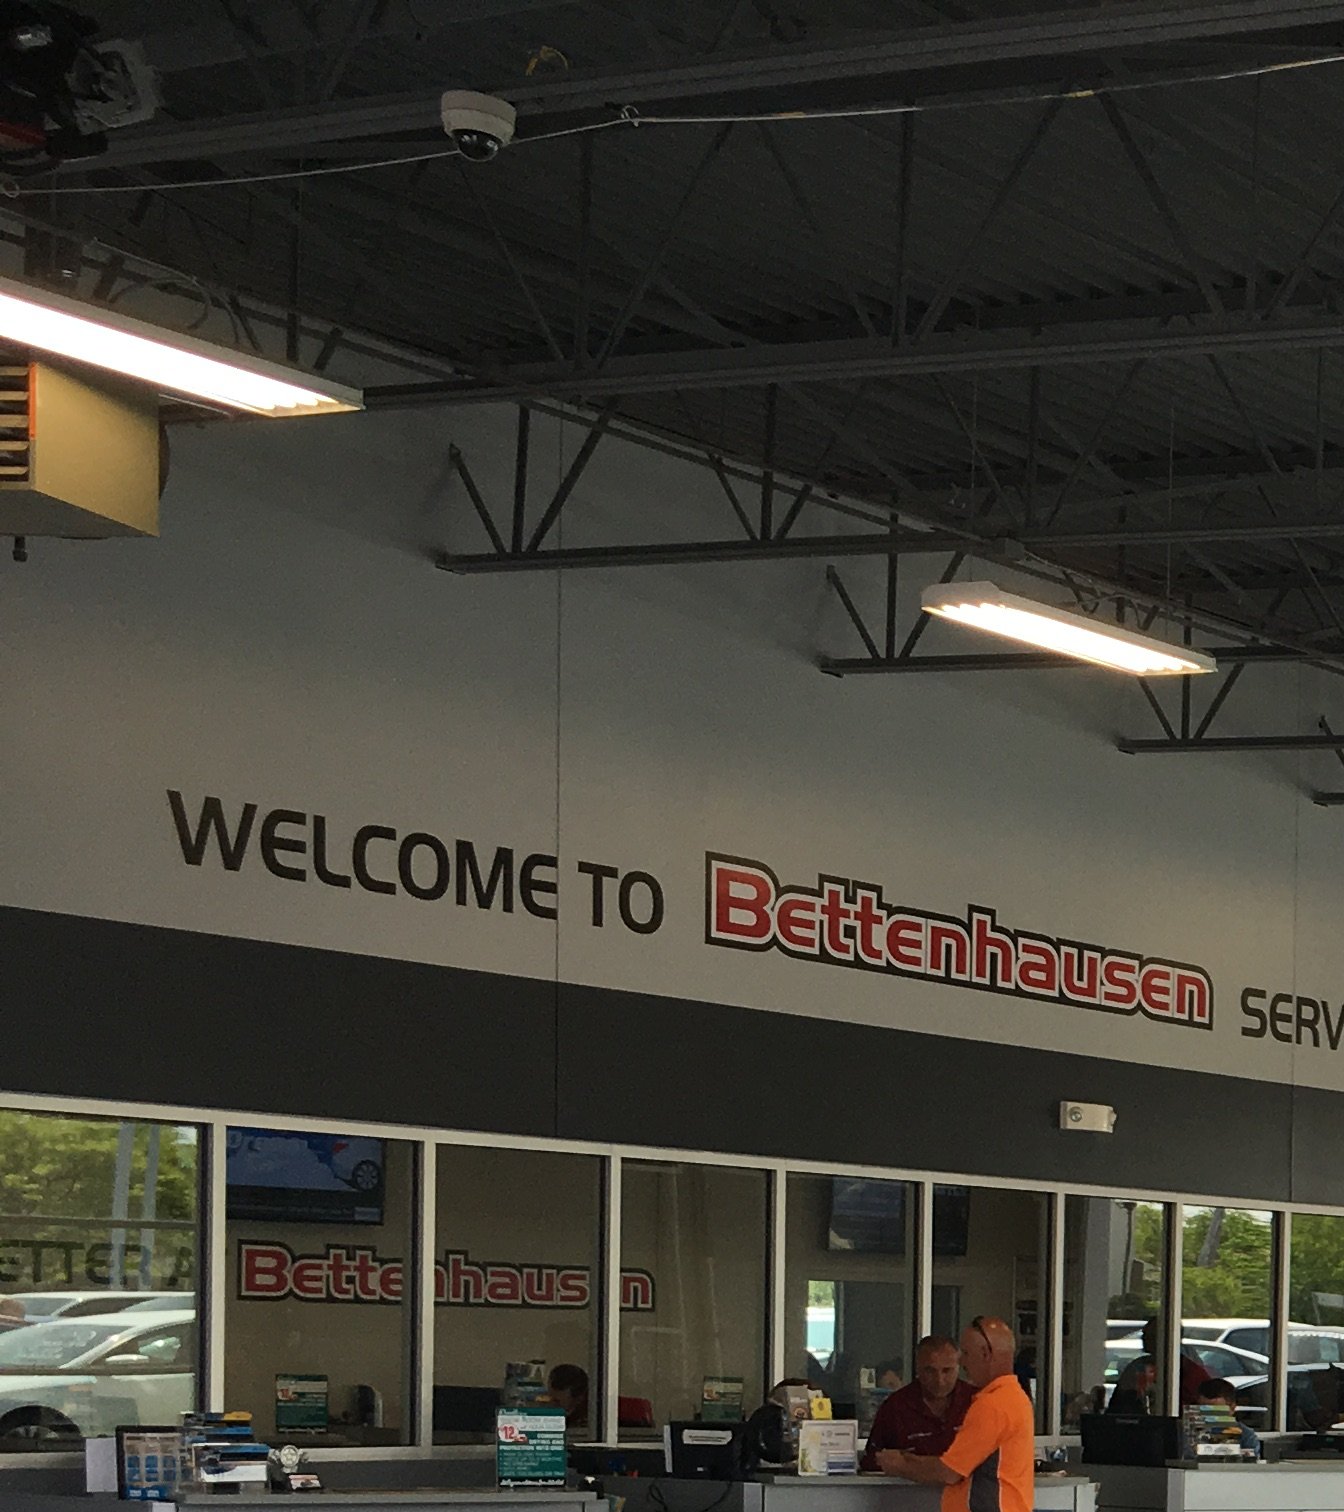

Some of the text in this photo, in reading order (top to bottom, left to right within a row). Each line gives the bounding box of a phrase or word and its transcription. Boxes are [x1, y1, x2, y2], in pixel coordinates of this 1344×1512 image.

[166, 789, 558, 920] WELCOME
[578, 862, 664, 934] TO
[708, 854, 1212, 1027] Bettenhausen
[239, 1240, 654, 1311] Bettehausn
